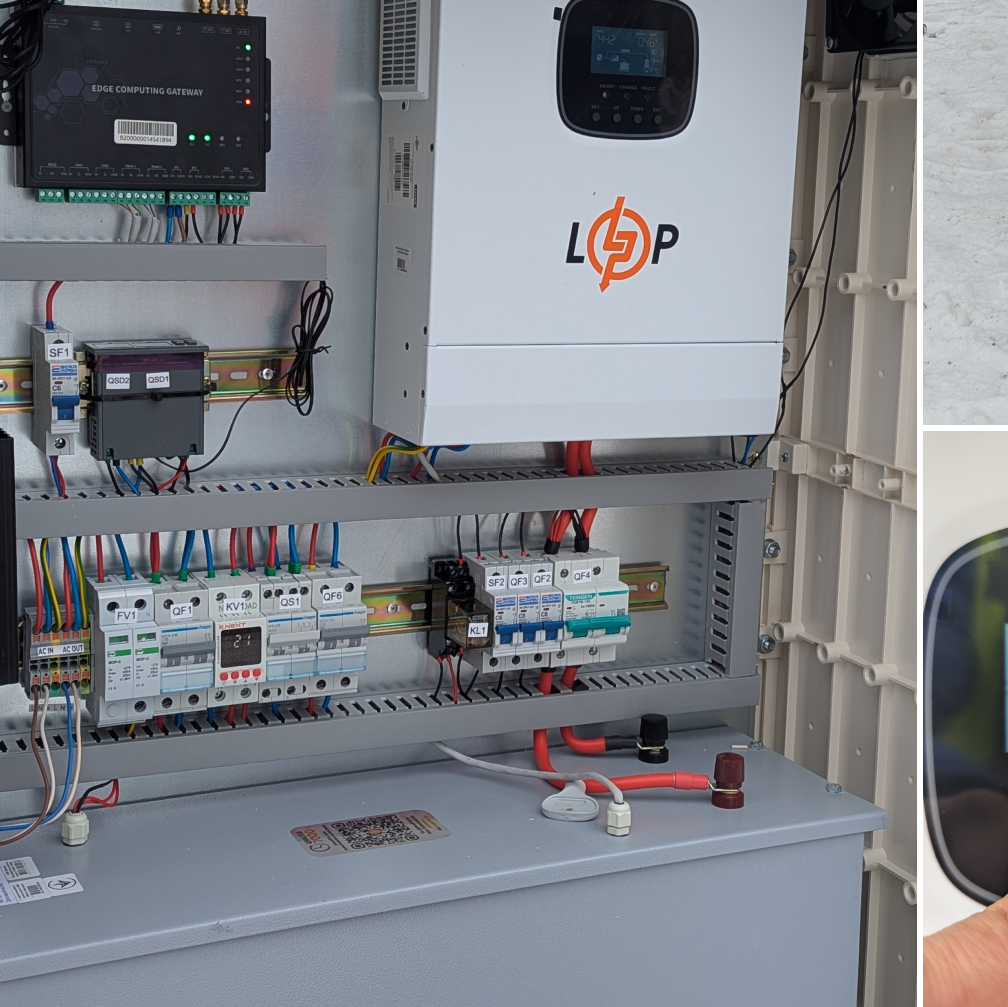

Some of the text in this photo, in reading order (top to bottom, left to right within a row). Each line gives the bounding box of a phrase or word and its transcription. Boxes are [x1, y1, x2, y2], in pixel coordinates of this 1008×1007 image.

[91, 84, 204, 97] EDGE COMPUTING GATEWAY
[49, 347, 69, 358] SF1
[107, 376, 130, 385] QSD2
[147, 375, 169, 384] QSD1
[534, 574, 551, 584] QF2
[573, 572, 591, 581] QF4
[488, 578, 505, 587] SF2
[510, 577, 528, 587] QF3
[323, 591, 343, 602] QF6
[226, 602, 245, 611] KV1
[280, 597, 300, 607] QS1
[172, 605, 192, 616] QF1
[117, 611, 136, 621] FV1
[469, 626, 486, 635] KL1
[38, 644, 83, 655] AC IN AC OUT
